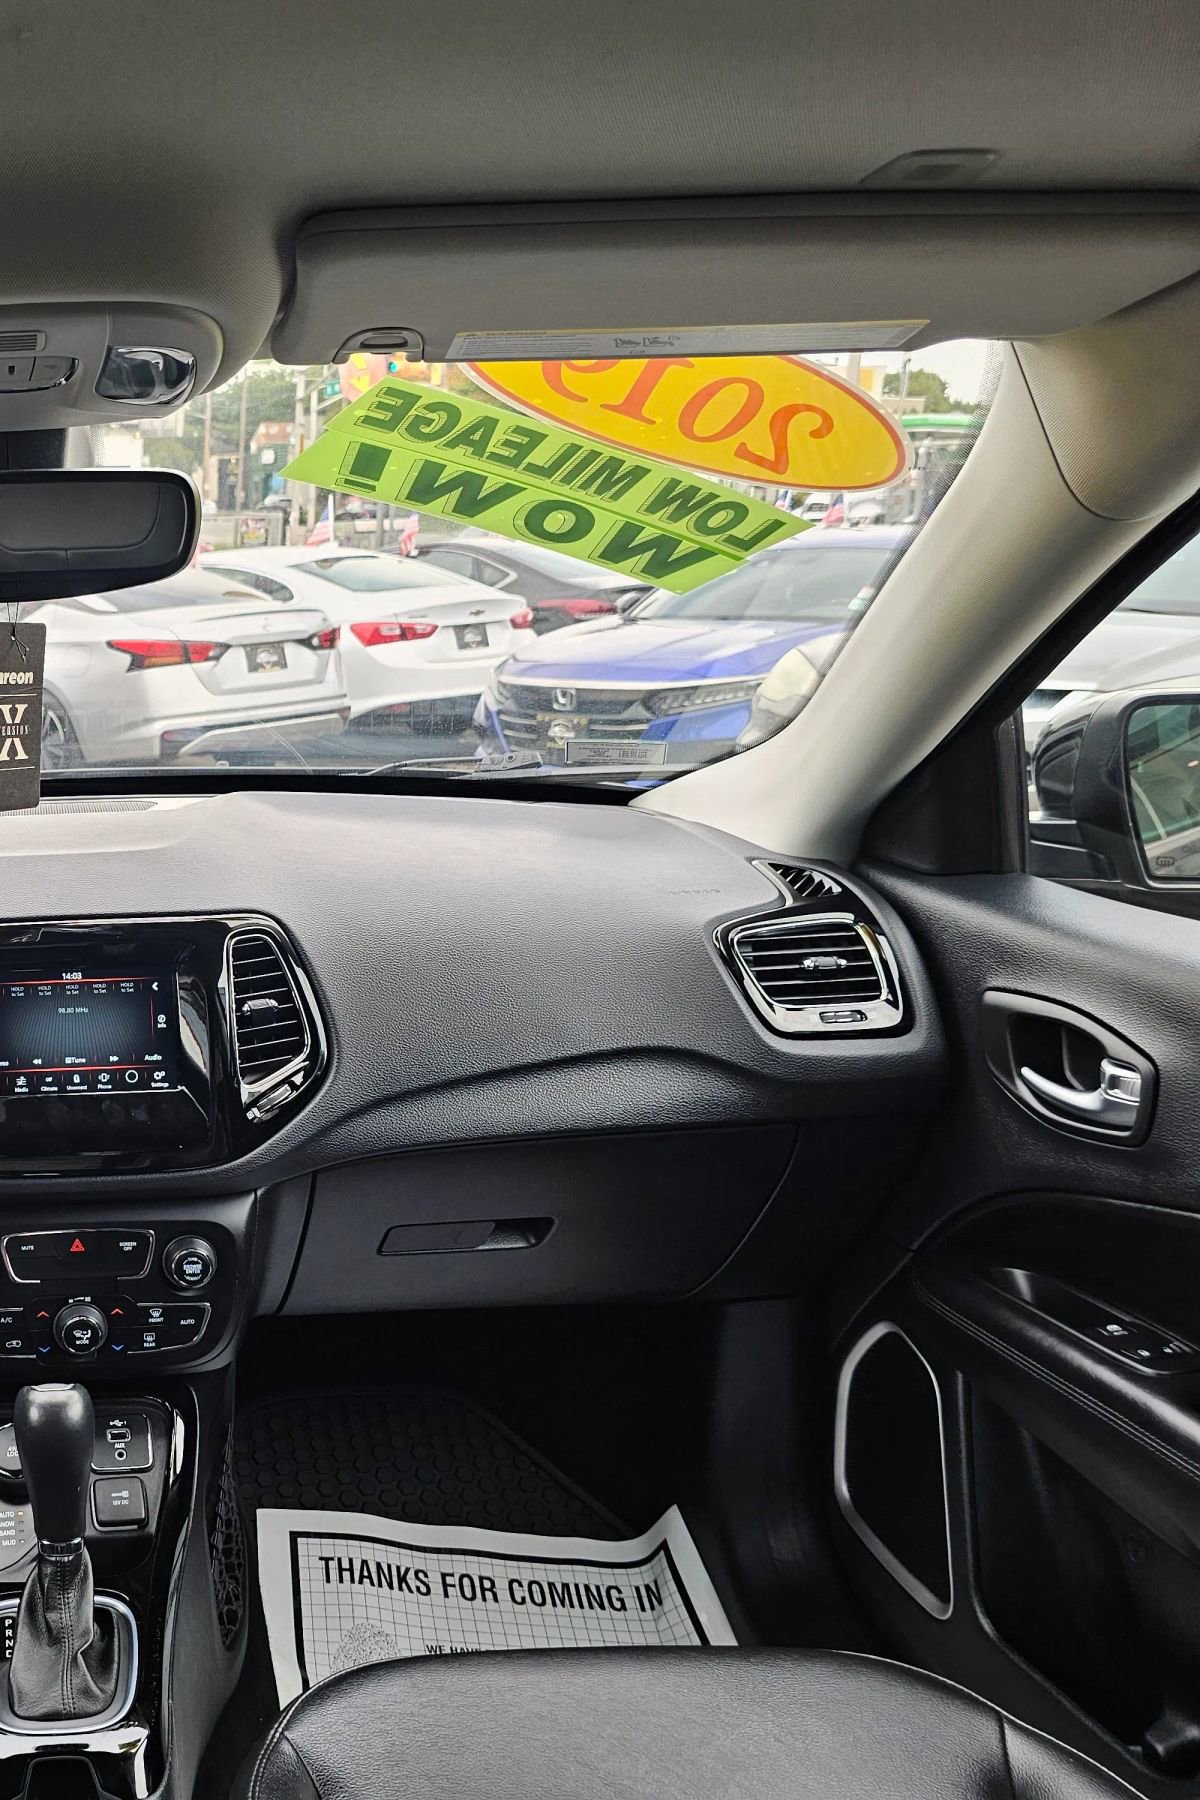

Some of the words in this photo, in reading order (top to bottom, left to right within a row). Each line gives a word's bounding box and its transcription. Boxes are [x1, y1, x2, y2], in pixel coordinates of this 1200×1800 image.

[61, 972, 82, 980] 14:03
[72, 1056, 86, 1064] Tune
[144, 1053, 162, 1061] Audio
[0, 1511, 15, 1519] AUTO
[0, 1529, 16, 1537] SAND
[318, 1556, 432, 1597] THANKS
[442, 1572, 499, 1604] FOR
[508, 1578, 627, 1613] COMING
[634, 1580, 664, 1613] IN
[5, 1619, 13, 1627] P
[6, 1629, 13, 1637] R
[6, 1639, 14, 1647] N
[426, 1644, 446, 1654] WE
